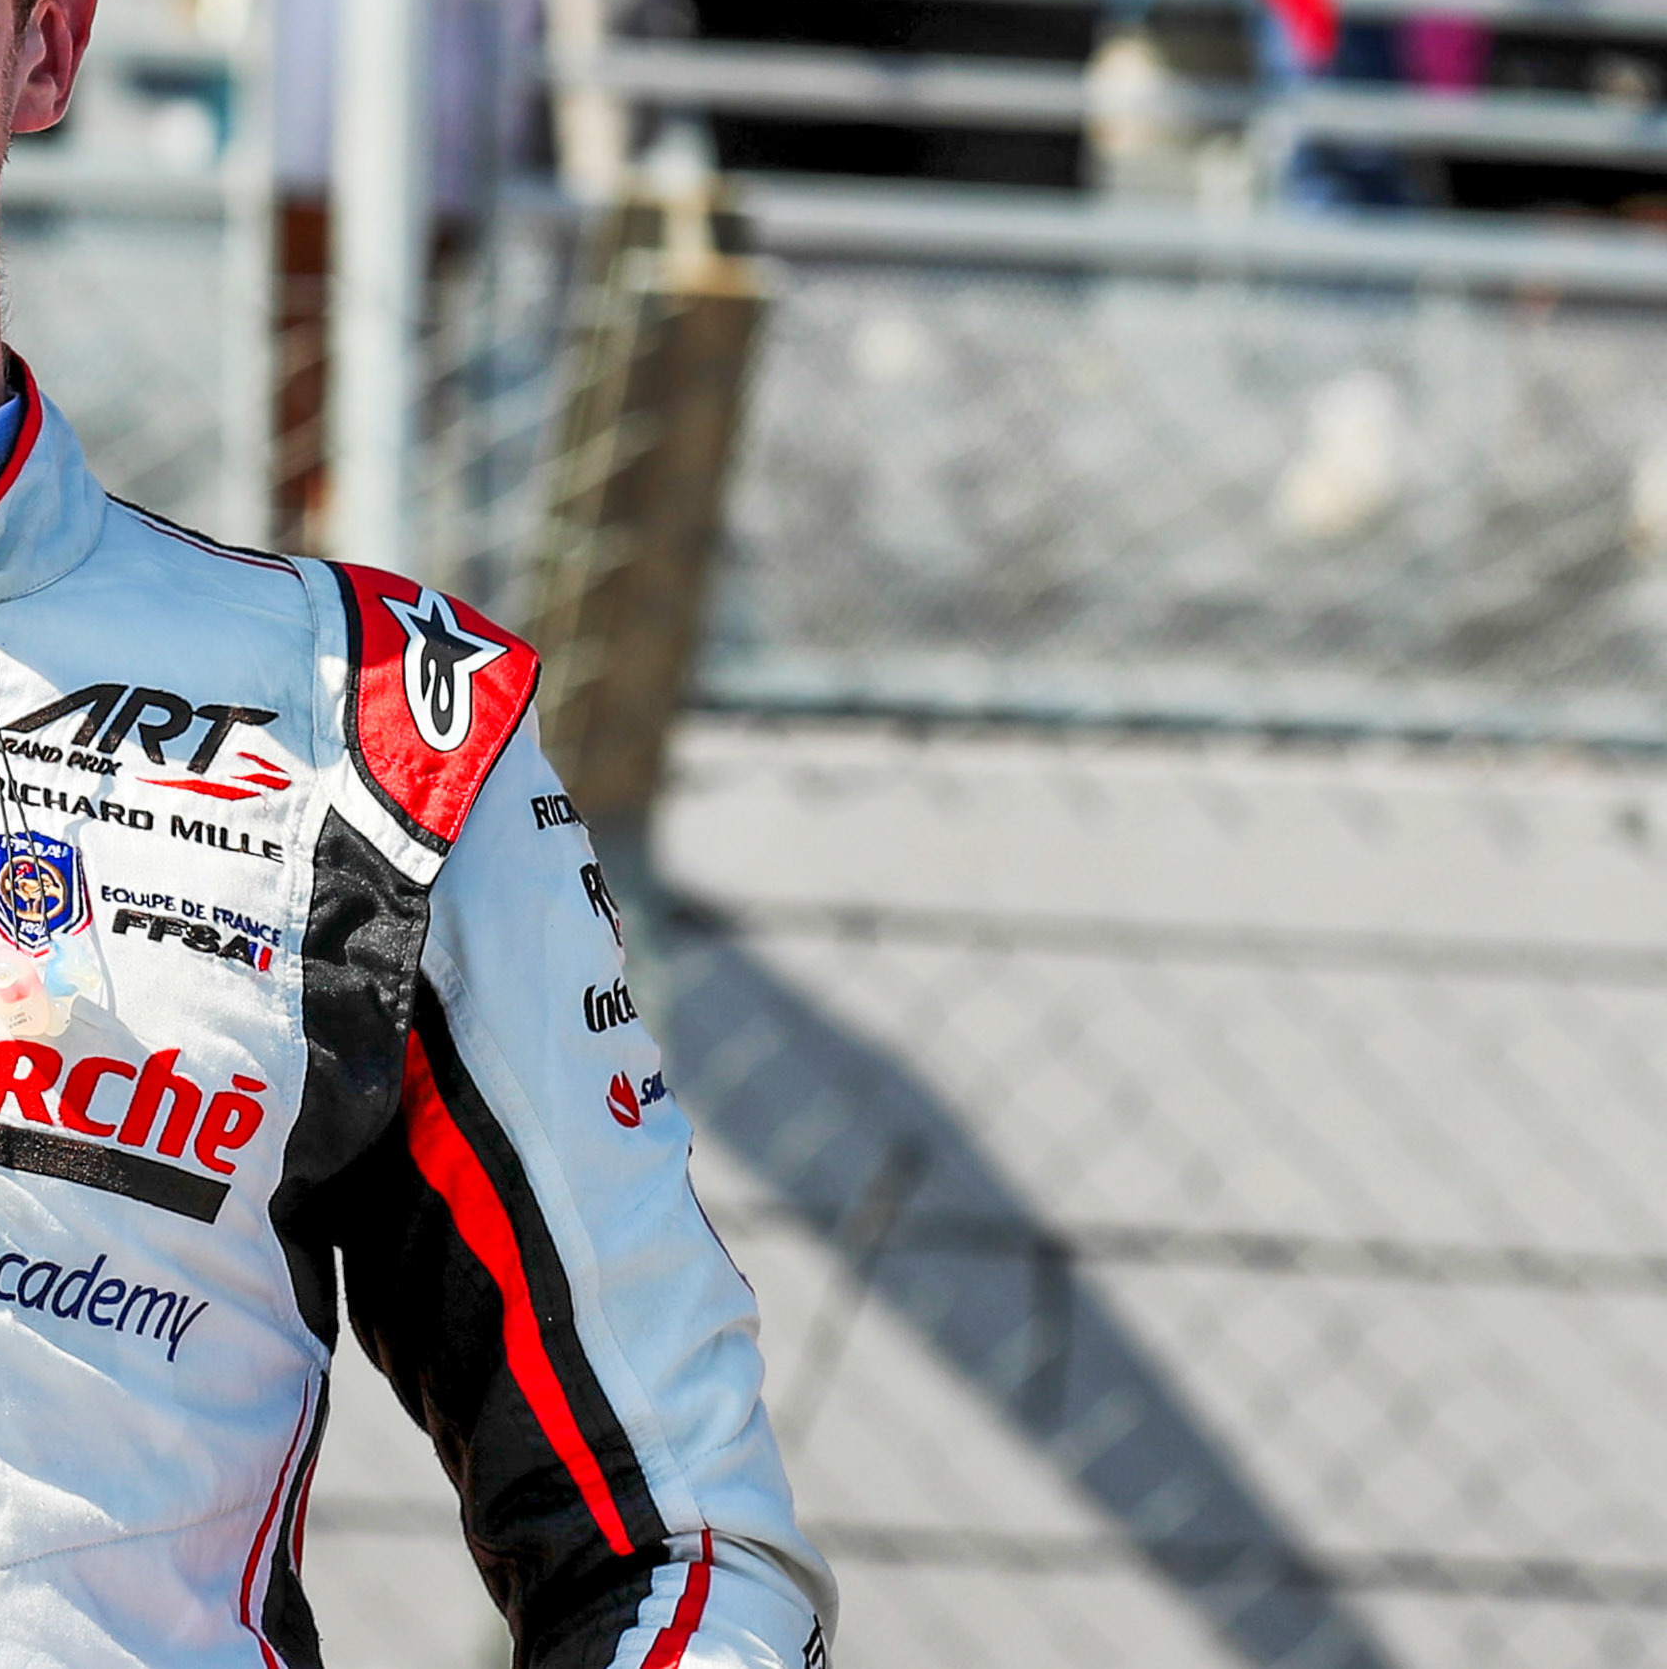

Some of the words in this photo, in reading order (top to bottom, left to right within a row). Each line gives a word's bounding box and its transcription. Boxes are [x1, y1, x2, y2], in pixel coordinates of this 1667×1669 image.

[0, 682, 279, 774] ART
[67, 750, 123, 777] PRIX
[171, 815, 285, 864] MILLE
[101, 885, 177, 912] EQUIPE
[181, 899, 207, 921] DE
[212, 906, 283, 948] FRANCE
[111, 908, 257, 969] FFSA
